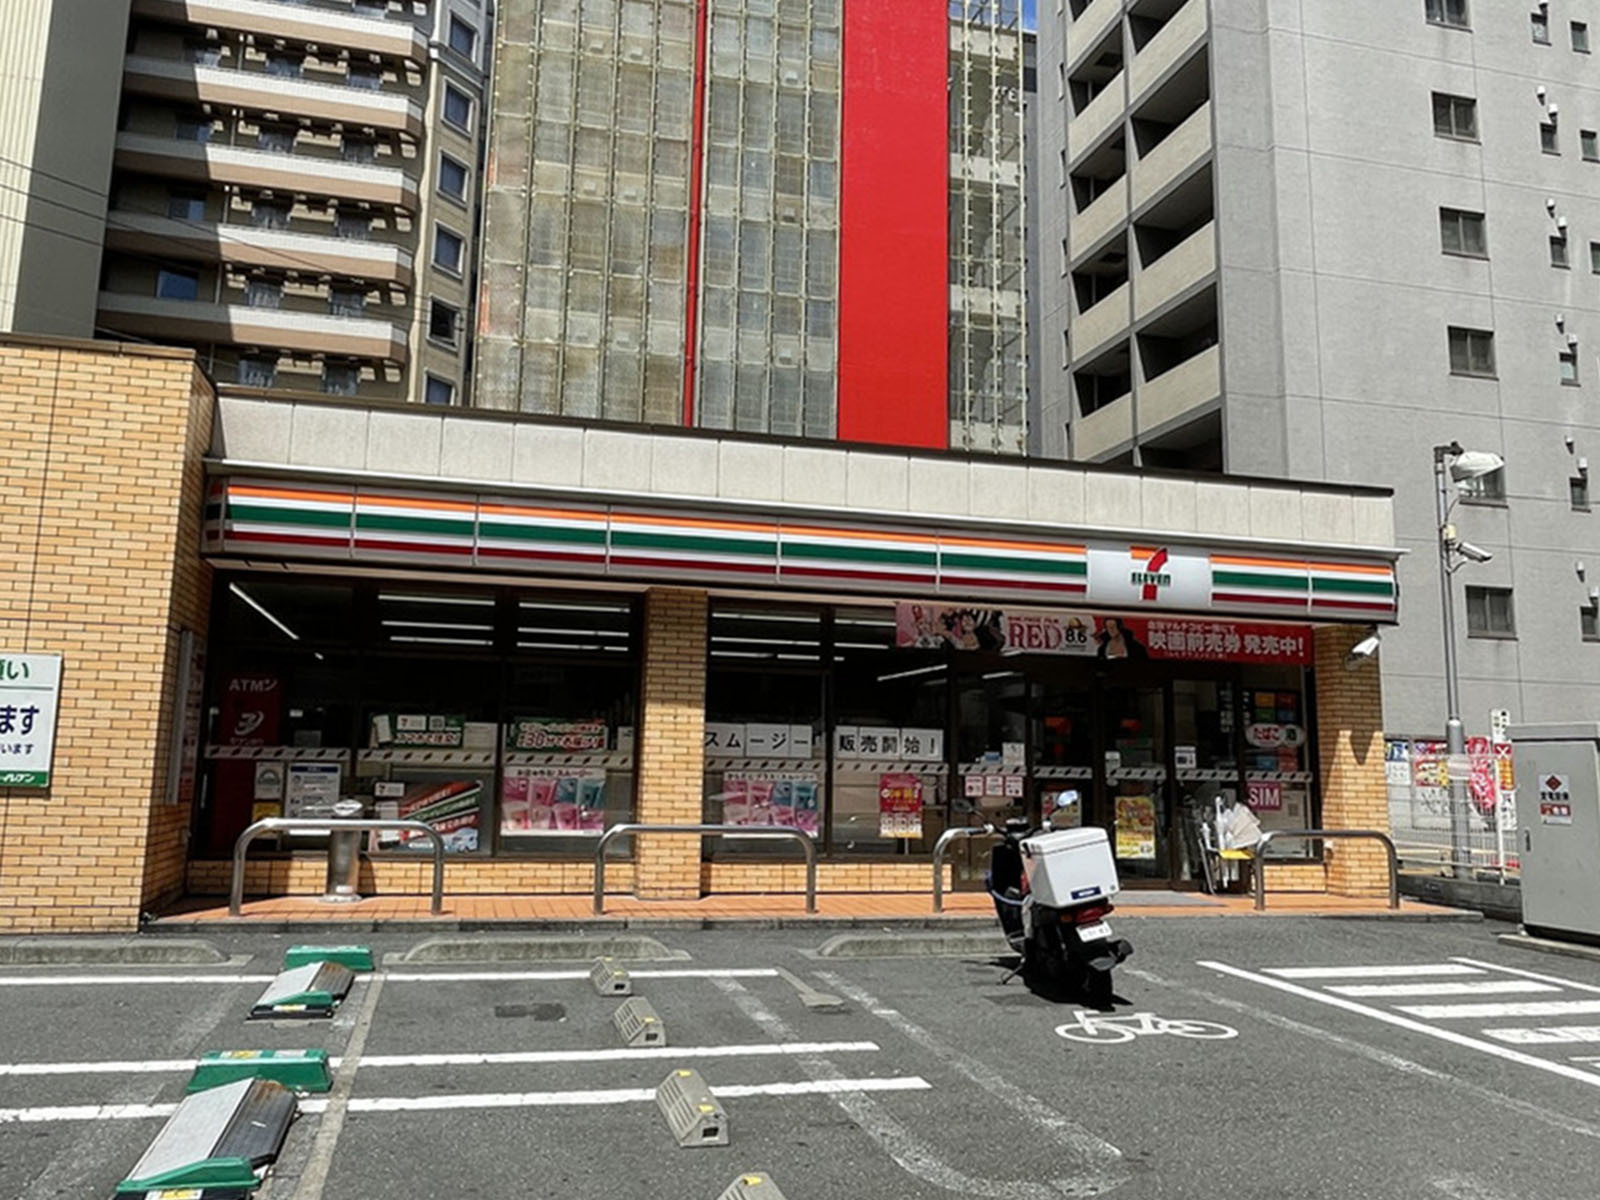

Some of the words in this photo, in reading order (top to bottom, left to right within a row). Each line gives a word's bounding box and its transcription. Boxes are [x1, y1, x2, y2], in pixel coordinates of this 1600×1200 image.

[1009, 623, 1062, 650] RED
[1147, 630, 1241, 654] 映画前売券
[705, 731, 808, 750] スムージー
[1247, 788, 1280, 806] SIM
